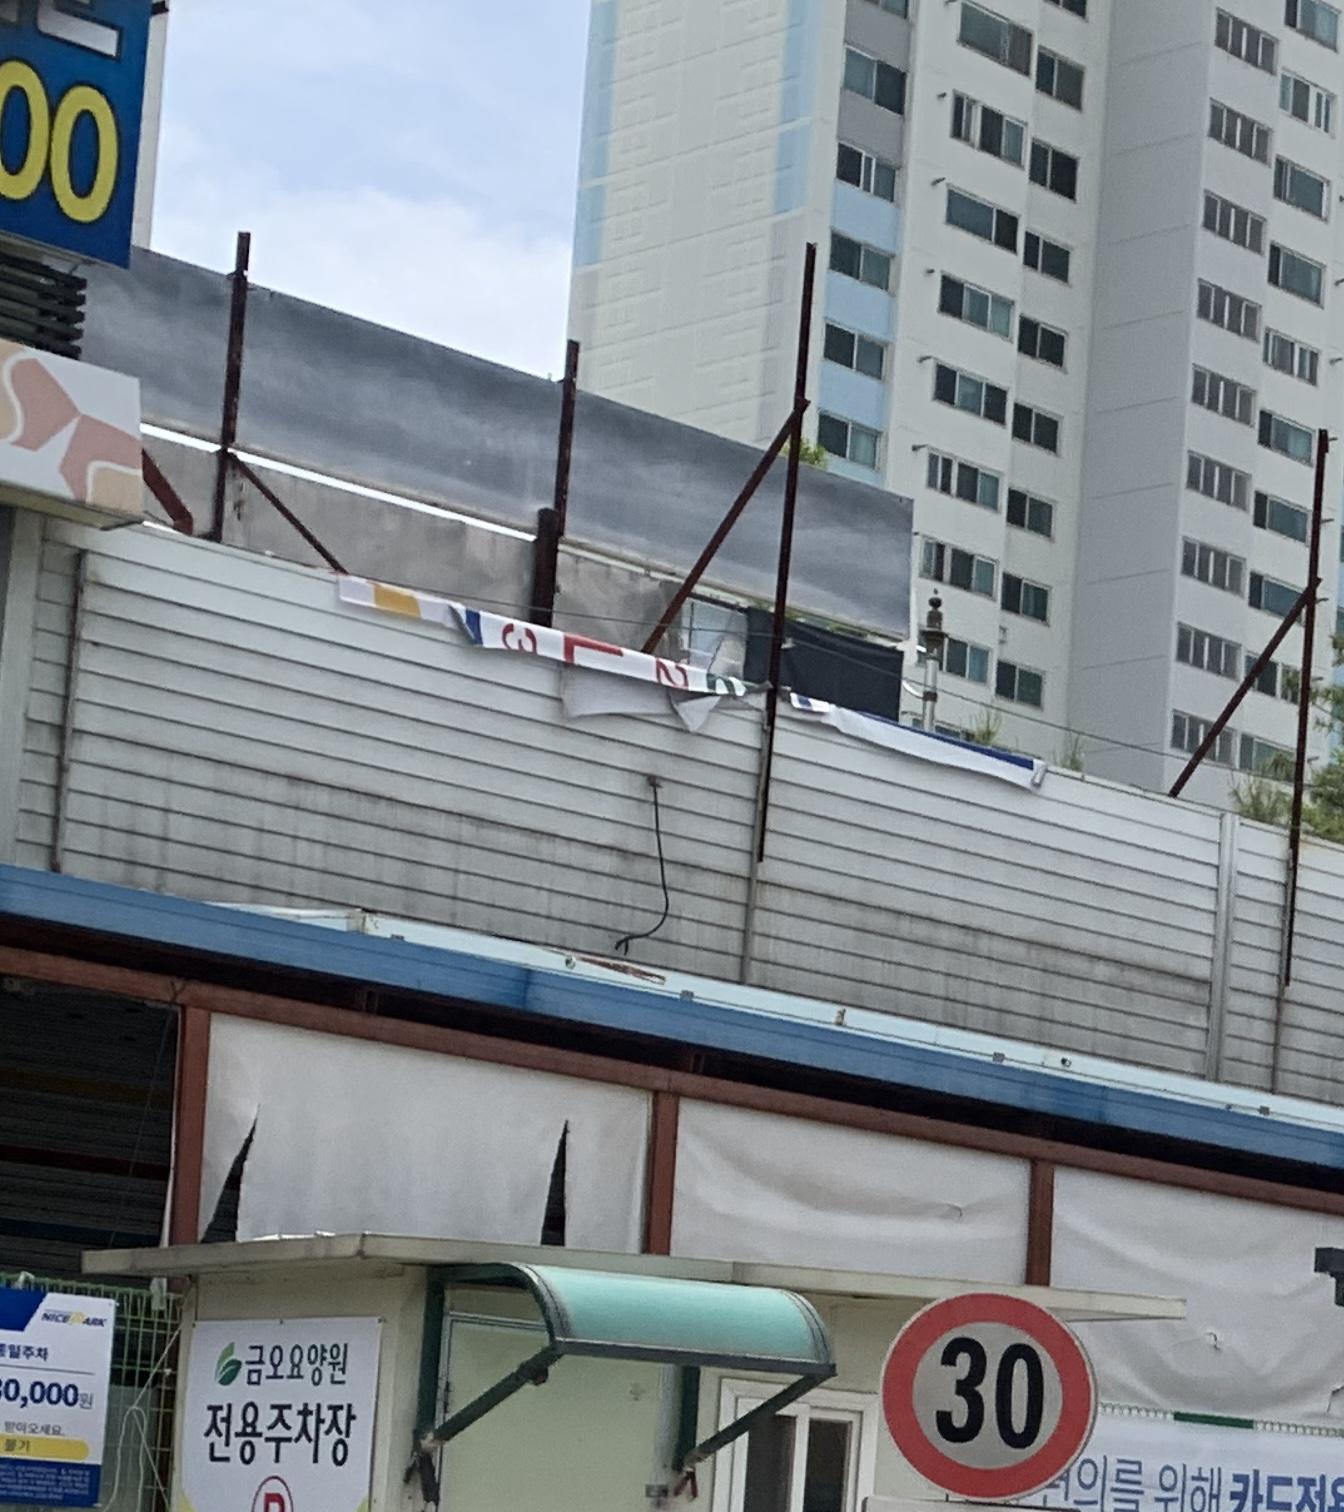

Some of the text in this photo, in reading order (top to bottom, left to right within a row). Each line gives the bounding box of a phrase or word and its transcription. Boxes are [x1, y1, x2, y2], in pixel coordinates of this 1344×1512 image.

[245, 1342, 348, 1386] 금오요양원
[935, 1336, 1045, 1449] 30
[204, 1401, 356, 1466] 전용주차장
